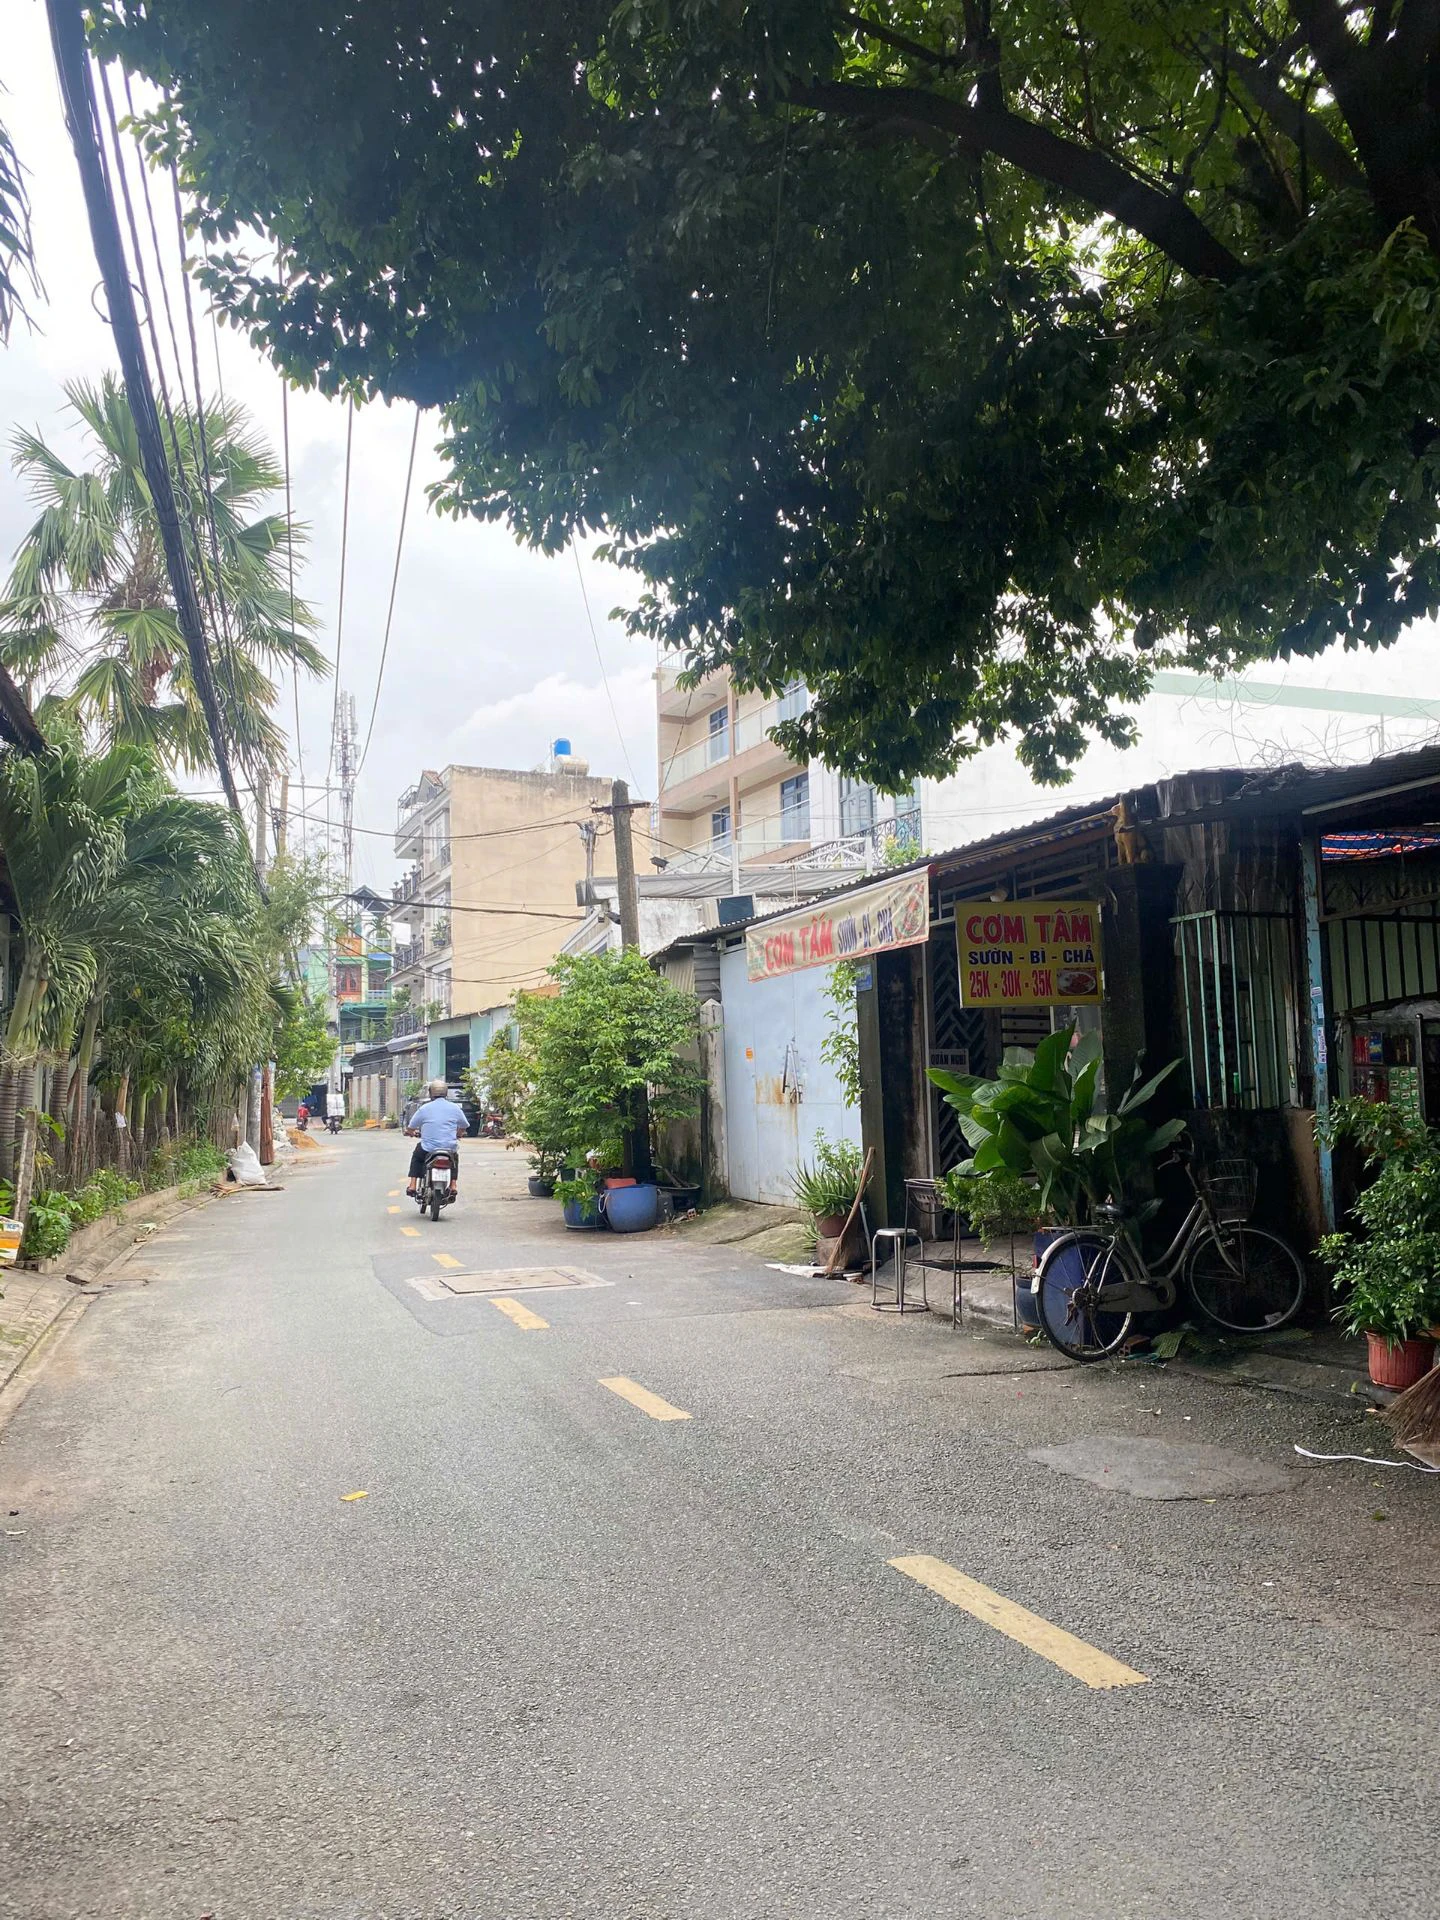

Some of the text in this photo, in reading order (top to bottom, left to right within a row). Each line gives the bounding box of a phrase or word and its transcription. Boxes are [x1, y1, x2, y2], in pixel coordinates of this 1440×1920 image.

[765, 930, 794, 970] CƠM
[799, 912, 833, 961] TẤM
[966, 908, 1092, 944] CƠM TẤM
[968, 948, 1013, 965] SƯỜN
[1030, 947, 1046, 964] BÌ
[1063, 945, 1095, 963] CHẢ
[969, 970, 991, 998] 25K
[1000, 970, 1022, 997] 30K
[1032, 969, 1053, 996] 35K
